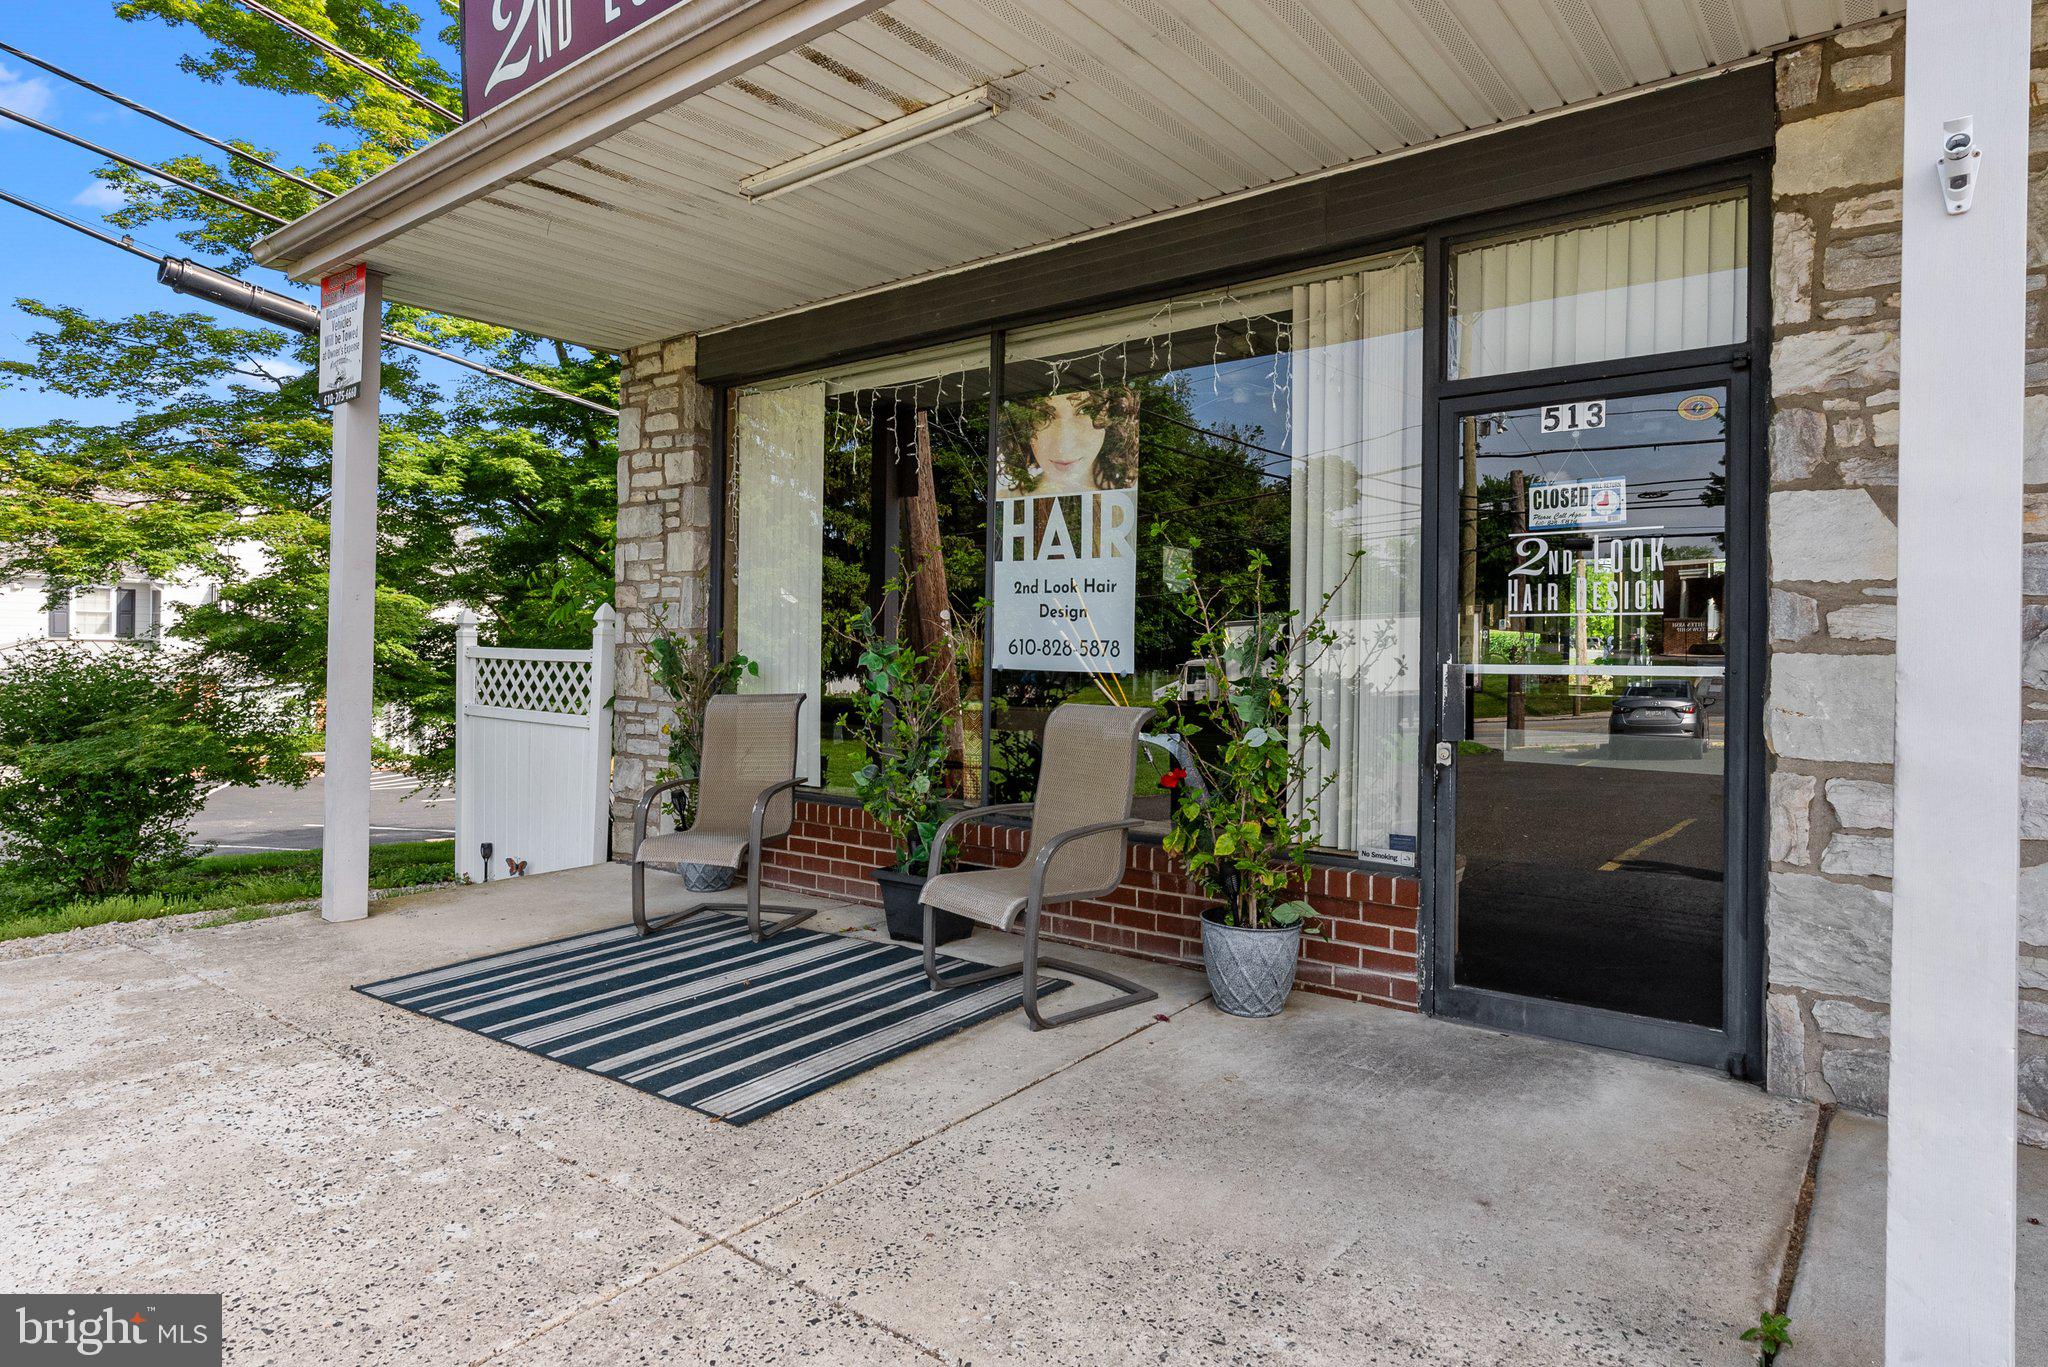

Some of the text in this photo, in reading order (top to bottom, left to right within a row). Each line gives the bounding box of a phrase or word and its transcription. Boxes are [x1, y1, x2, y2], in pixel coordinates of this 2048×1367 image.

[332, 316, 352, 331] Vehicles
[335, 332, 341, 345] be
[342, 326, 359, 342] Towed
[344, 342, 360, 354] Expense
[1543, 403, 1604, 431] 513
[1533, 486, 1589, 510] CLOSED
[1553, 512, 1567, 520] Call
[1002, 491, 1136, 561] HAIR
[1508, 534, 1664, 577] 2ND LOOK
[1014, 578, 1117, 594] 2nd Look Hair
[1508, 577, 1664, 611] HAIR DESIGN
[1039, 604, 1088, 621] Design
[1008, 638, 1121, 658] 610-828-5878
[1361, 850, 1398, 862] No Smoking
